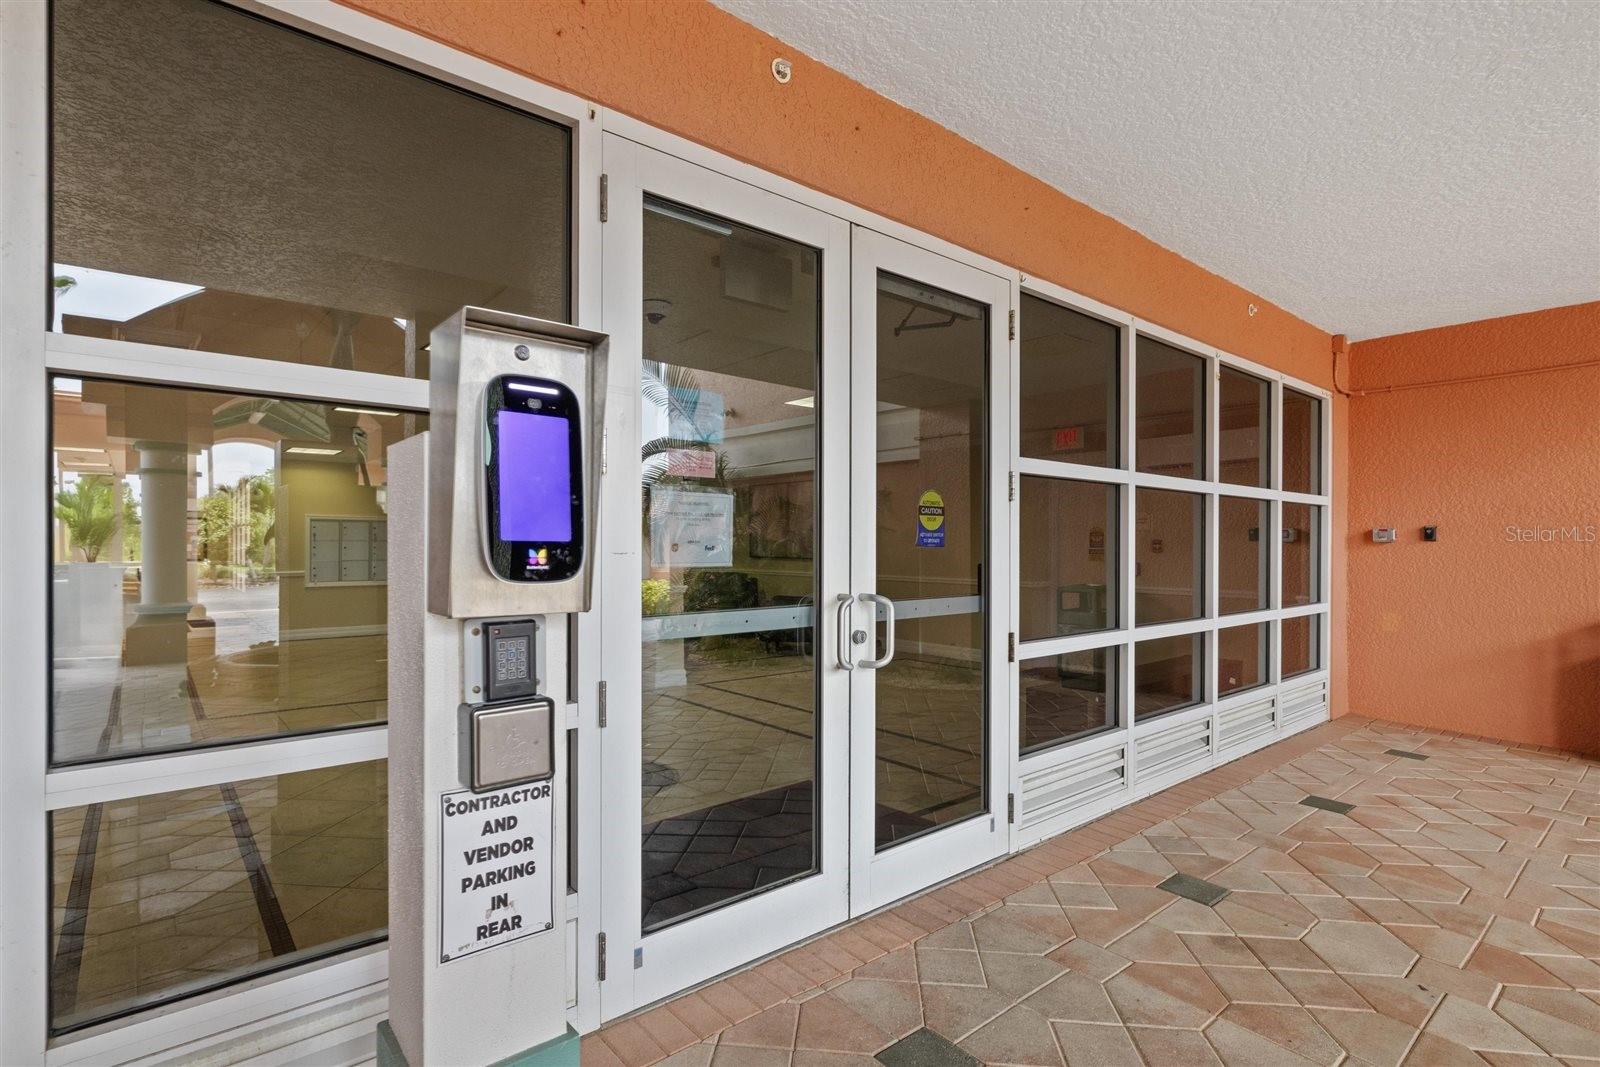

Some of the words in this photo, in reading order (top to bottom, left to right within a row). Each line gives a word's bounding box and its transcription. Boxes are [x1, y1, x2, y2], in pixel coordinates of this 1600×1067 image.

[445, 784, 551, 817] CONTRACTOR
[481, 815, 518, 836] AND
[463, 836, 534, 866] VENDOR
[461, 860, 537, 893] PARKING
[491, 892, 508, 911] IN
[476, 914, 522, 941] REAR
